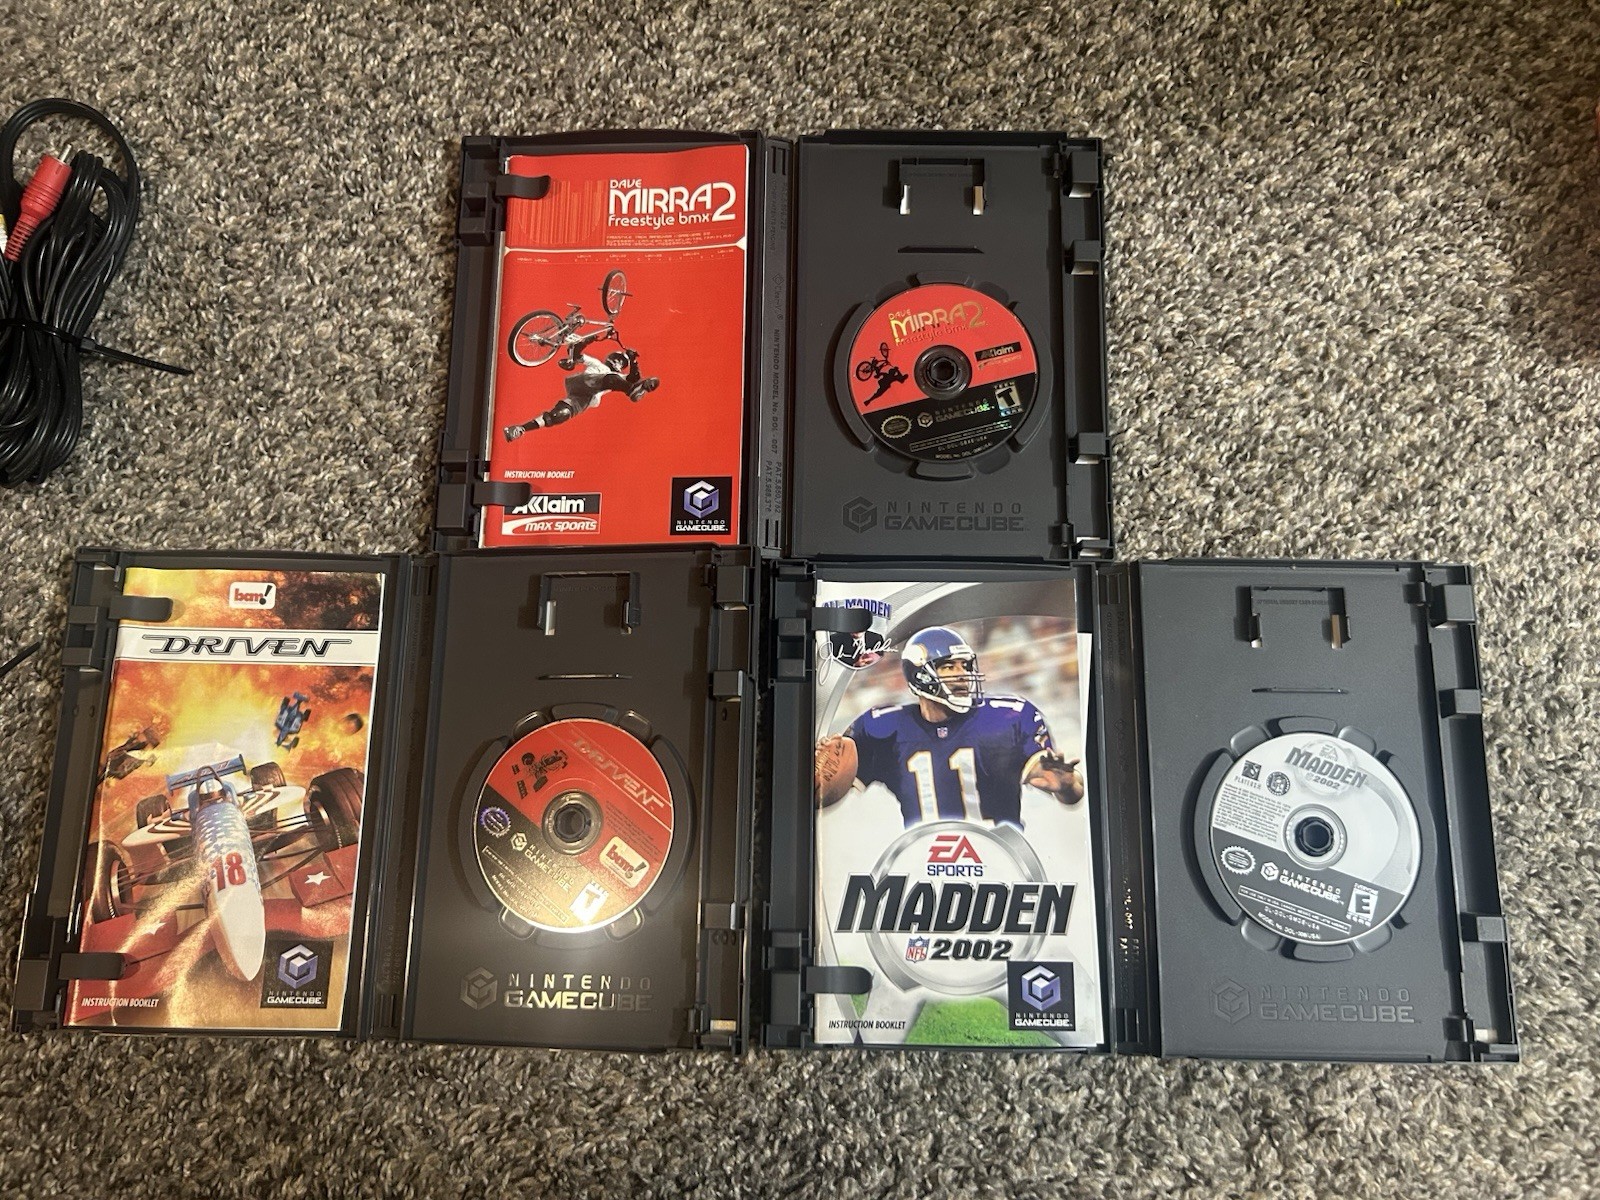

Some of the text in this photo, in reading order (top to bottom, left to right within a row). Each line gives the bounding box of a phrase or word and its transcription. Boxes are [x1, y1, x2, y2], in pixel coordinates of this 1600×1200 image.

[610, 179, 642, 188] DAVE
[888, 309, 911, 321] DAVE
[998, 388, 1016, 409] T
[935, 403, 991, 423] GAMECUBE
[504, 470, 576, 479] INSTRUCTION BOOKLET
[887, 501, 1022, 514] NINTENDO
[676, 524, 726, 532] GAMECUBE
[884, 515, 1024, 532] GAMECUBE
[142, 634, 352, 657] DRIVEN
[1284, 747, 1368, 788] MADDEN
[907, 747, 983, 823] 11
[1313, 774, 1340, 790] 2002
[927, 835, 983, 864] EA
[210, 852, 247, 892] 18
[524, 850, 571, 892] GAMECUBE
[926, 864, 984, 877] SPORTS
[1279, 875, 1340, 903] GAMECUBE
[1282, 868, 1341, 894] NINTENDO
[834, 872, 1078, 936] MADDEN
[1354, 892, 1371, 915] E
[930, 938, 1013, 961] 2002
[508, 973, 650, 990] NINTENDO
[82, 998, 159, 1008] INSTRUCTION BOOKLET
[267, 996, 322, 1005] GAMECUBE
[504, 990, 653, 1012] GAMECUBE
[1261, 986, 1410, 1002] NINTENDO
[1014, 1018, 1071, 1027] GAMECUBE
[1260, 1003, 1414, 1024] GAMECUBE
[828, 1019, 906, 1030] INSTRUCTION BOOKLET
